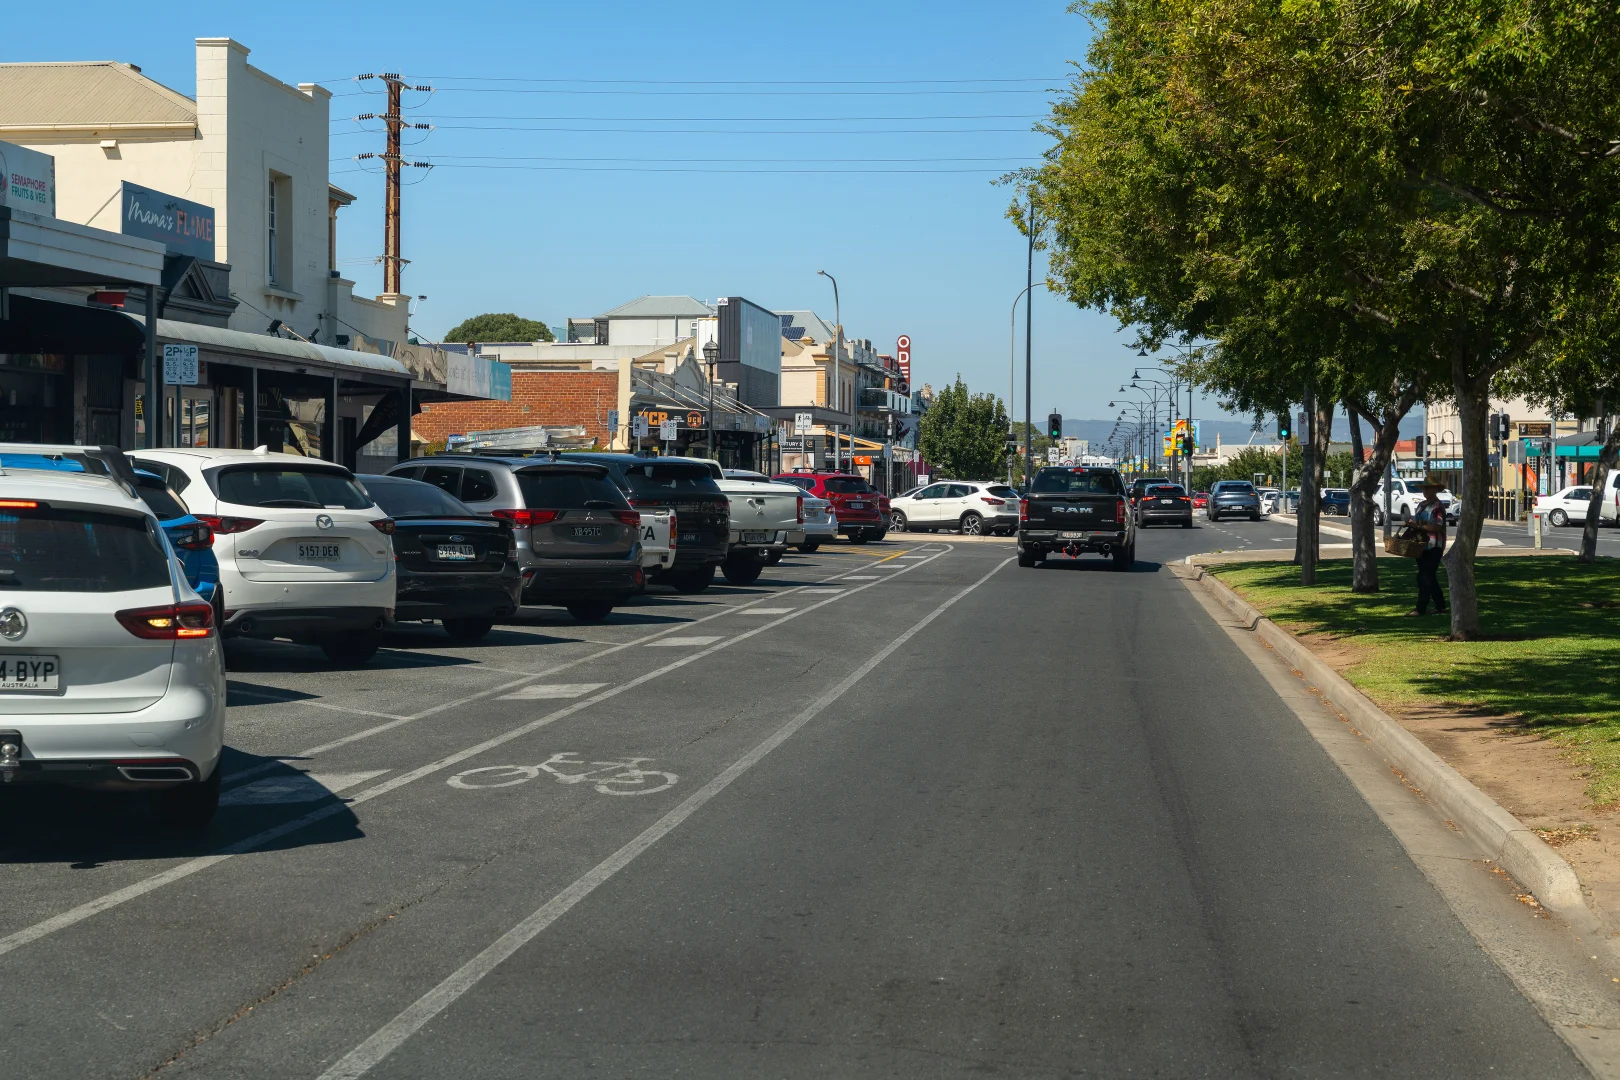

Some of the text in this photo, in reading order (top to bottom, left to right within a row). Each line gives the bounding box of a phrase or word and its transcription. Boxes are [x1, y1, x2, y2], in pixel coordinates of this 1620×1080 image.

[12, 173, 46, 192] SEMAPHORE
[12, 185, 46, 204] FRUITS & VEG
[127, 195, 174, 231] Mama's
[165, 346, 180, 357] 2P
[1425, 461, 1461, 469] ENTIST
[1051, 506, 1093, 514] RAM
